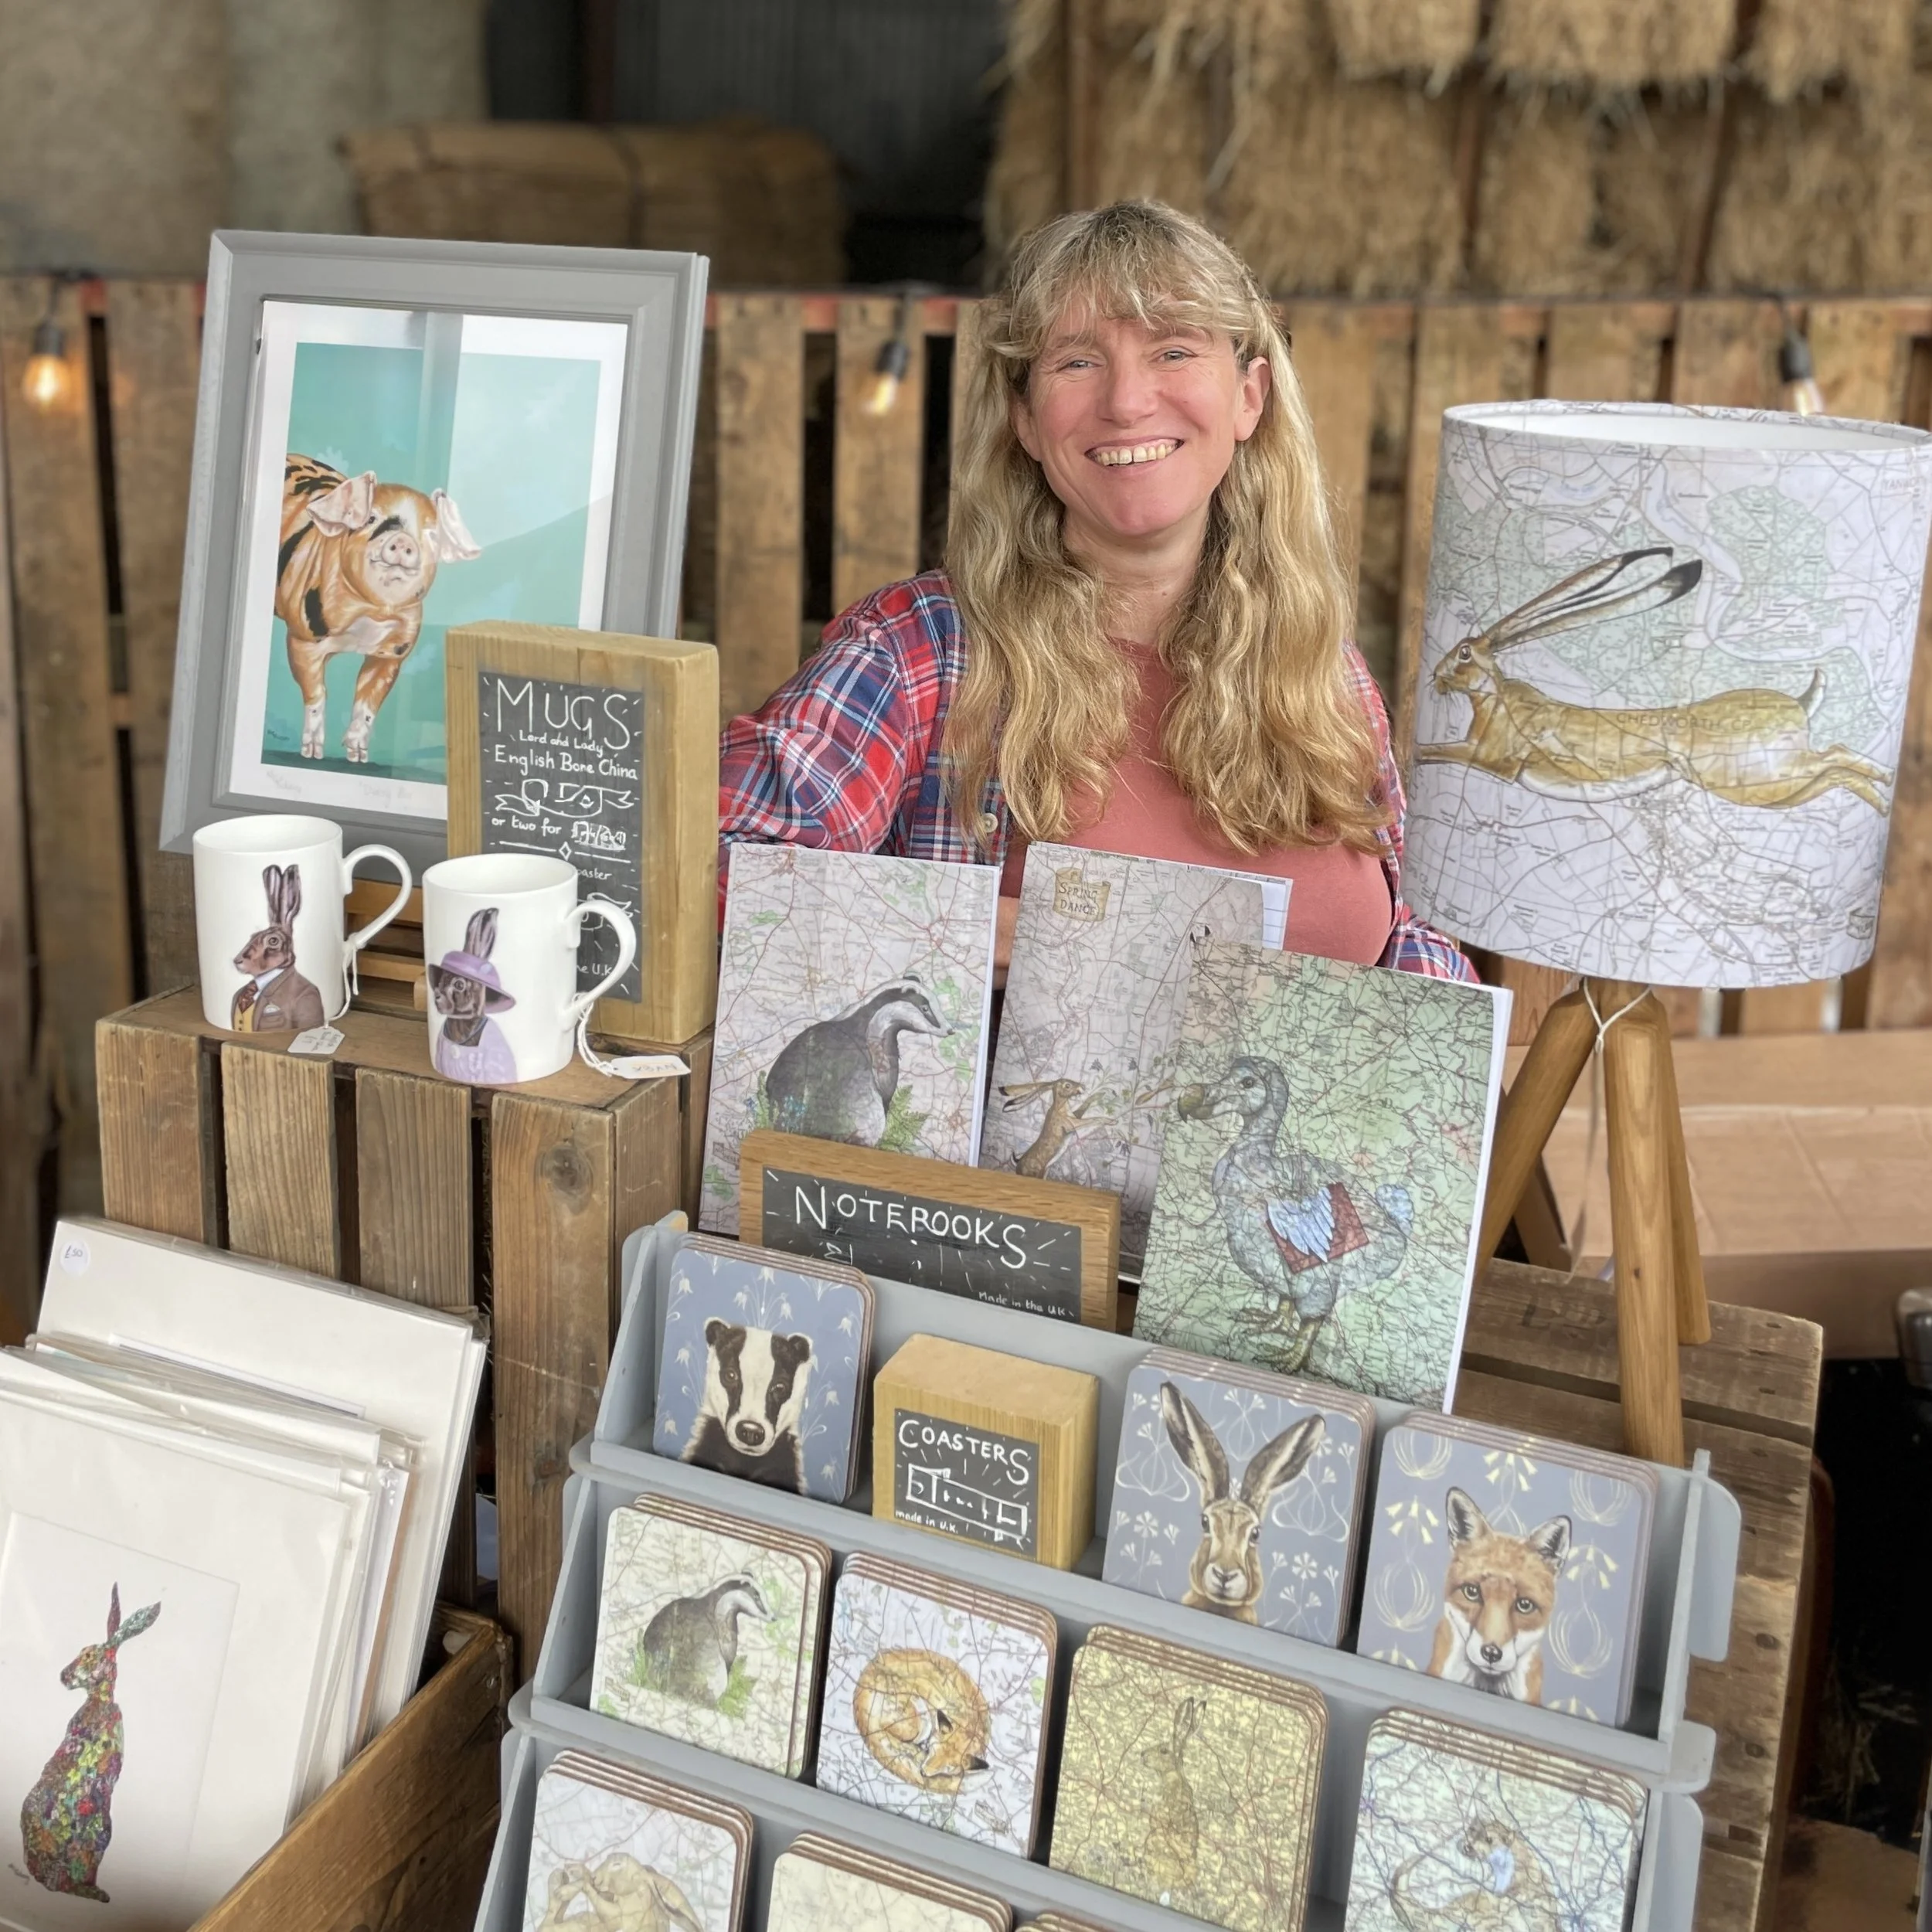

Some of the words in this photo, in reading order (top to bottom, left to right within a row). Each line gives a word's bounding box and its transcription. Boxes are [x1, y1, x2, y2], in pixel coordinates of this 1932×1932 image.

[497, 678, 631, 750] MUGS
[519, 730, 548, 744] Lord
[549, 734, 570, 747] and
[573, 737, 604, 758] Lady
[495, 744, 555, 776] English
[560, 752, 595, 774] Bone
[598, 758, 638, 781] China
[512, 815, 536, 832] two
[541, 818, 563, 837] for
[1060, 899, 1097, 916] DANCE
[978, 1291, 1008, 1304] Made
[1012, 1299, 1021, 1308] in
[1047, 1304, 1066, 1316] UK
[898, 1419, 1030, 1485] COASTERS
[895, 1511, 922, 1524] made
[925, 1515, 936, 1528] in
